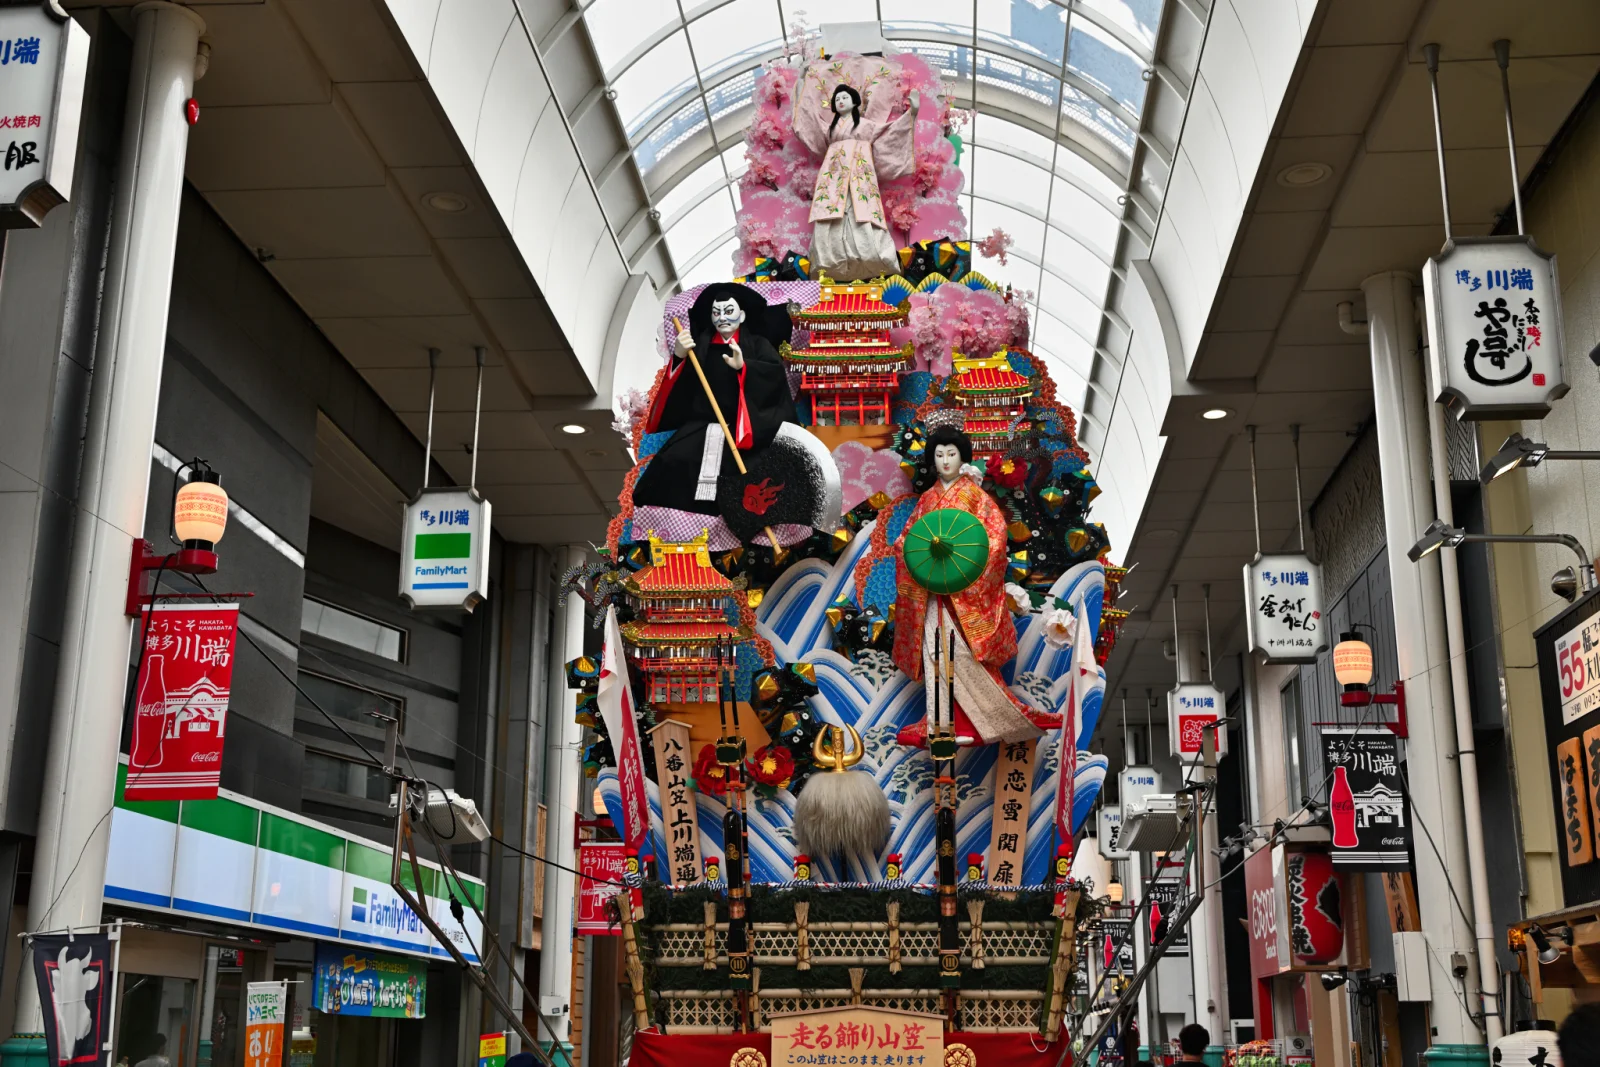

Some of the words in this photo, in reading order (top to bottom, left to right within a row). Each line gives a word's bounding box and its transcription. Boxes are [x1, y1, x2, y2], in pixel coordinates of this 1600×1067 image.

[1455, 268, 1533, 292] 博多川端
[420, 509, 469, 526] 博多川端
[415, 566, 467, 576] FamilyMart
[1262, 571, 1309, 586] 博多川端
[1259, 594, 1306, 618] 釜あげ
[148, 619, 196, 632] ようこそ
[145, 634, 231, 667] 博多川端
[1180, 697, 1215, 708] 博多川端
[1328, 740, 1365, 750] ようこそ
[1327, 751, 1397, 776] 博多川端
[1128, 776, 1155, 786] 博多川端
[663, 738, 700, 882] 八番山笠上川端通
[583, 857, 623, 874] 博多川端
[787, 1053, 926, 1066] この山笠はこのまま、走ります
